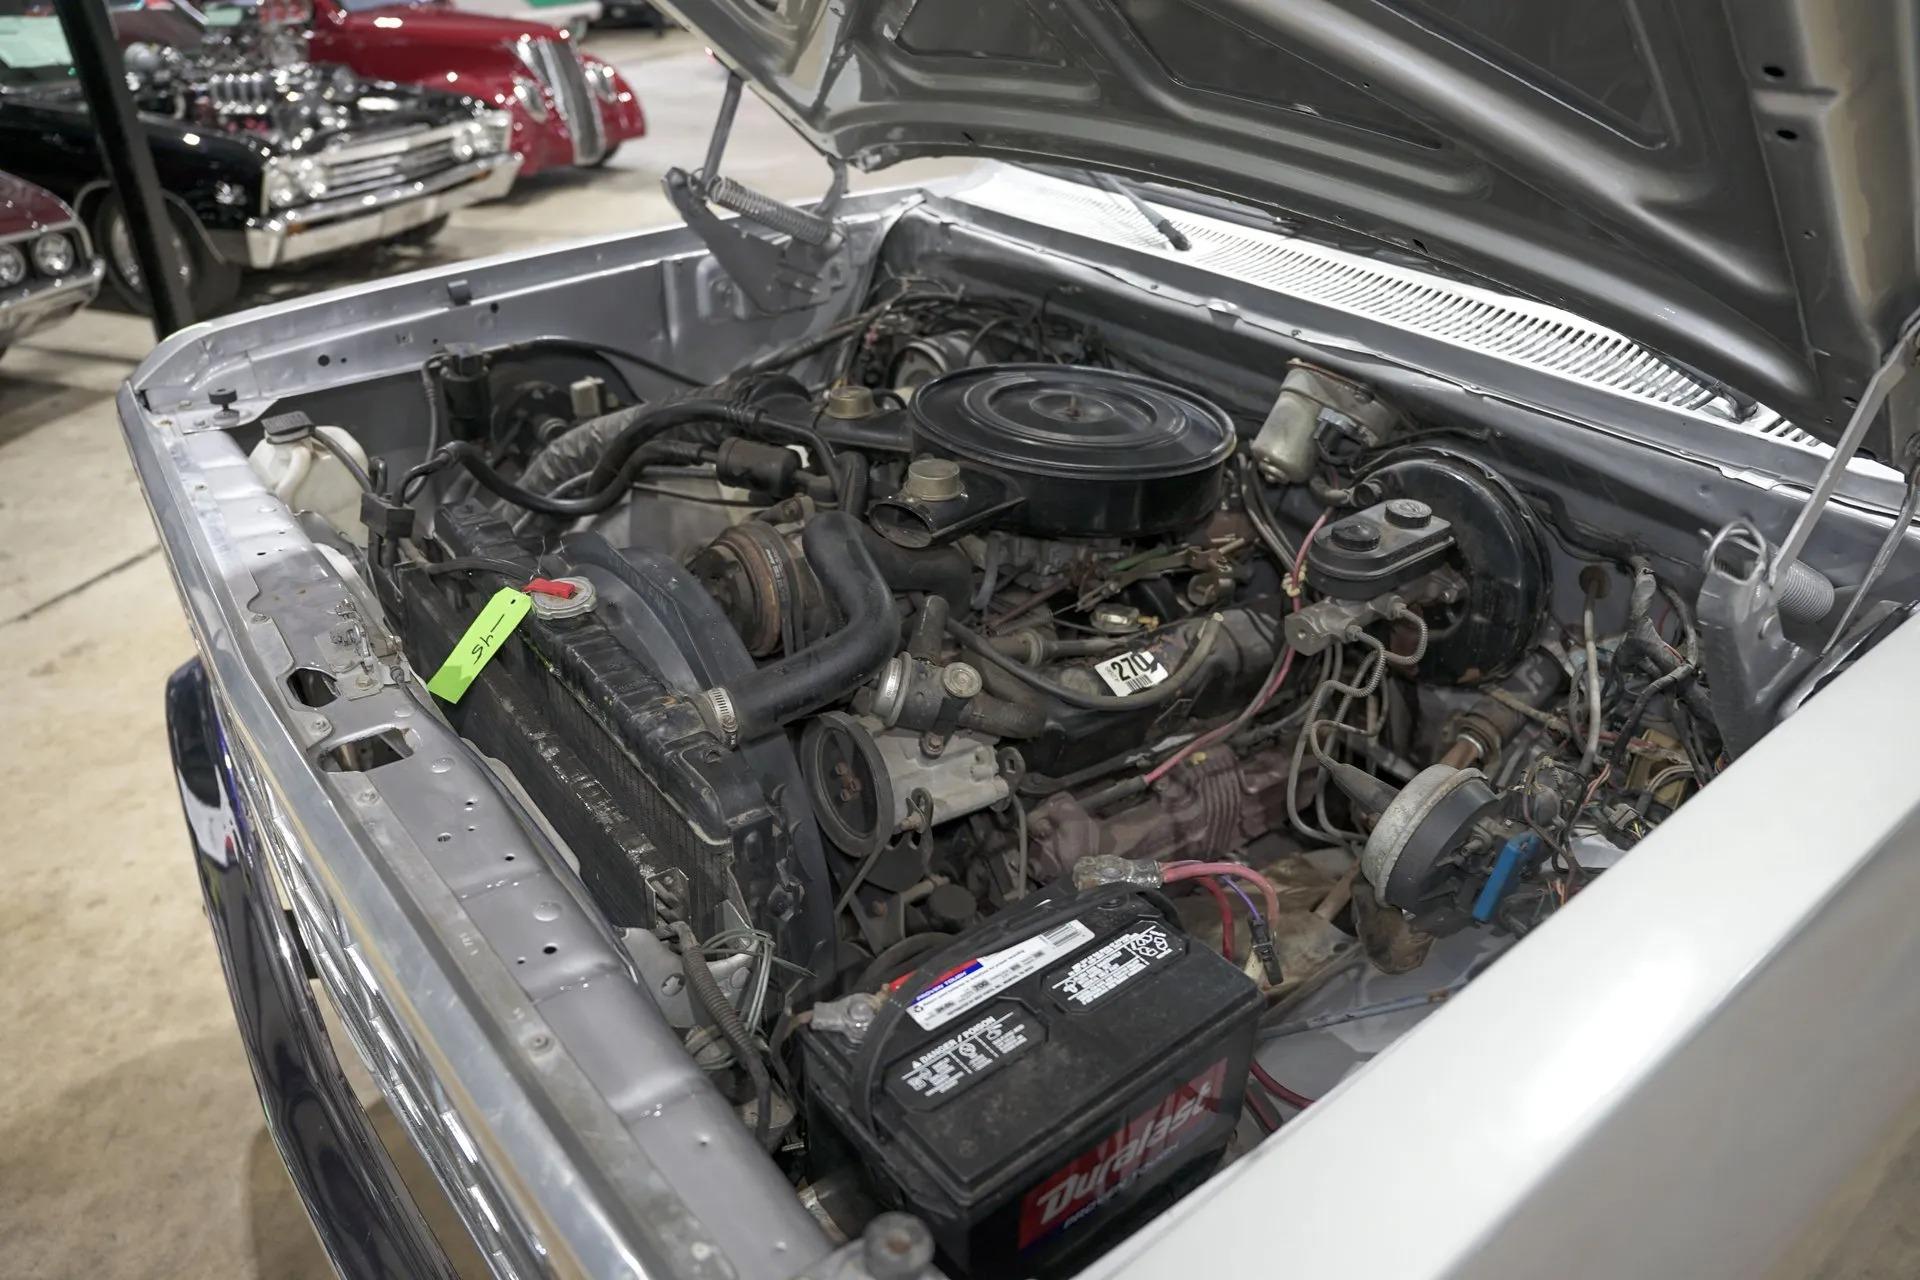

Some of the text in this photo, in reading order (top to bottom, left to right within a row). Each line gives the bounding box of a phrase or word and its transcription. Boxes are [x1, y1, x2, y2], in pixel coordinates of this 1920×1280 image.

[1110, 653, 1151, 681] 270
[919, 1039, 958, 1063] DANGER
[962, 1016, 996, 1038] POISON
[1036, 1081, 1213, 1225] Duralast
